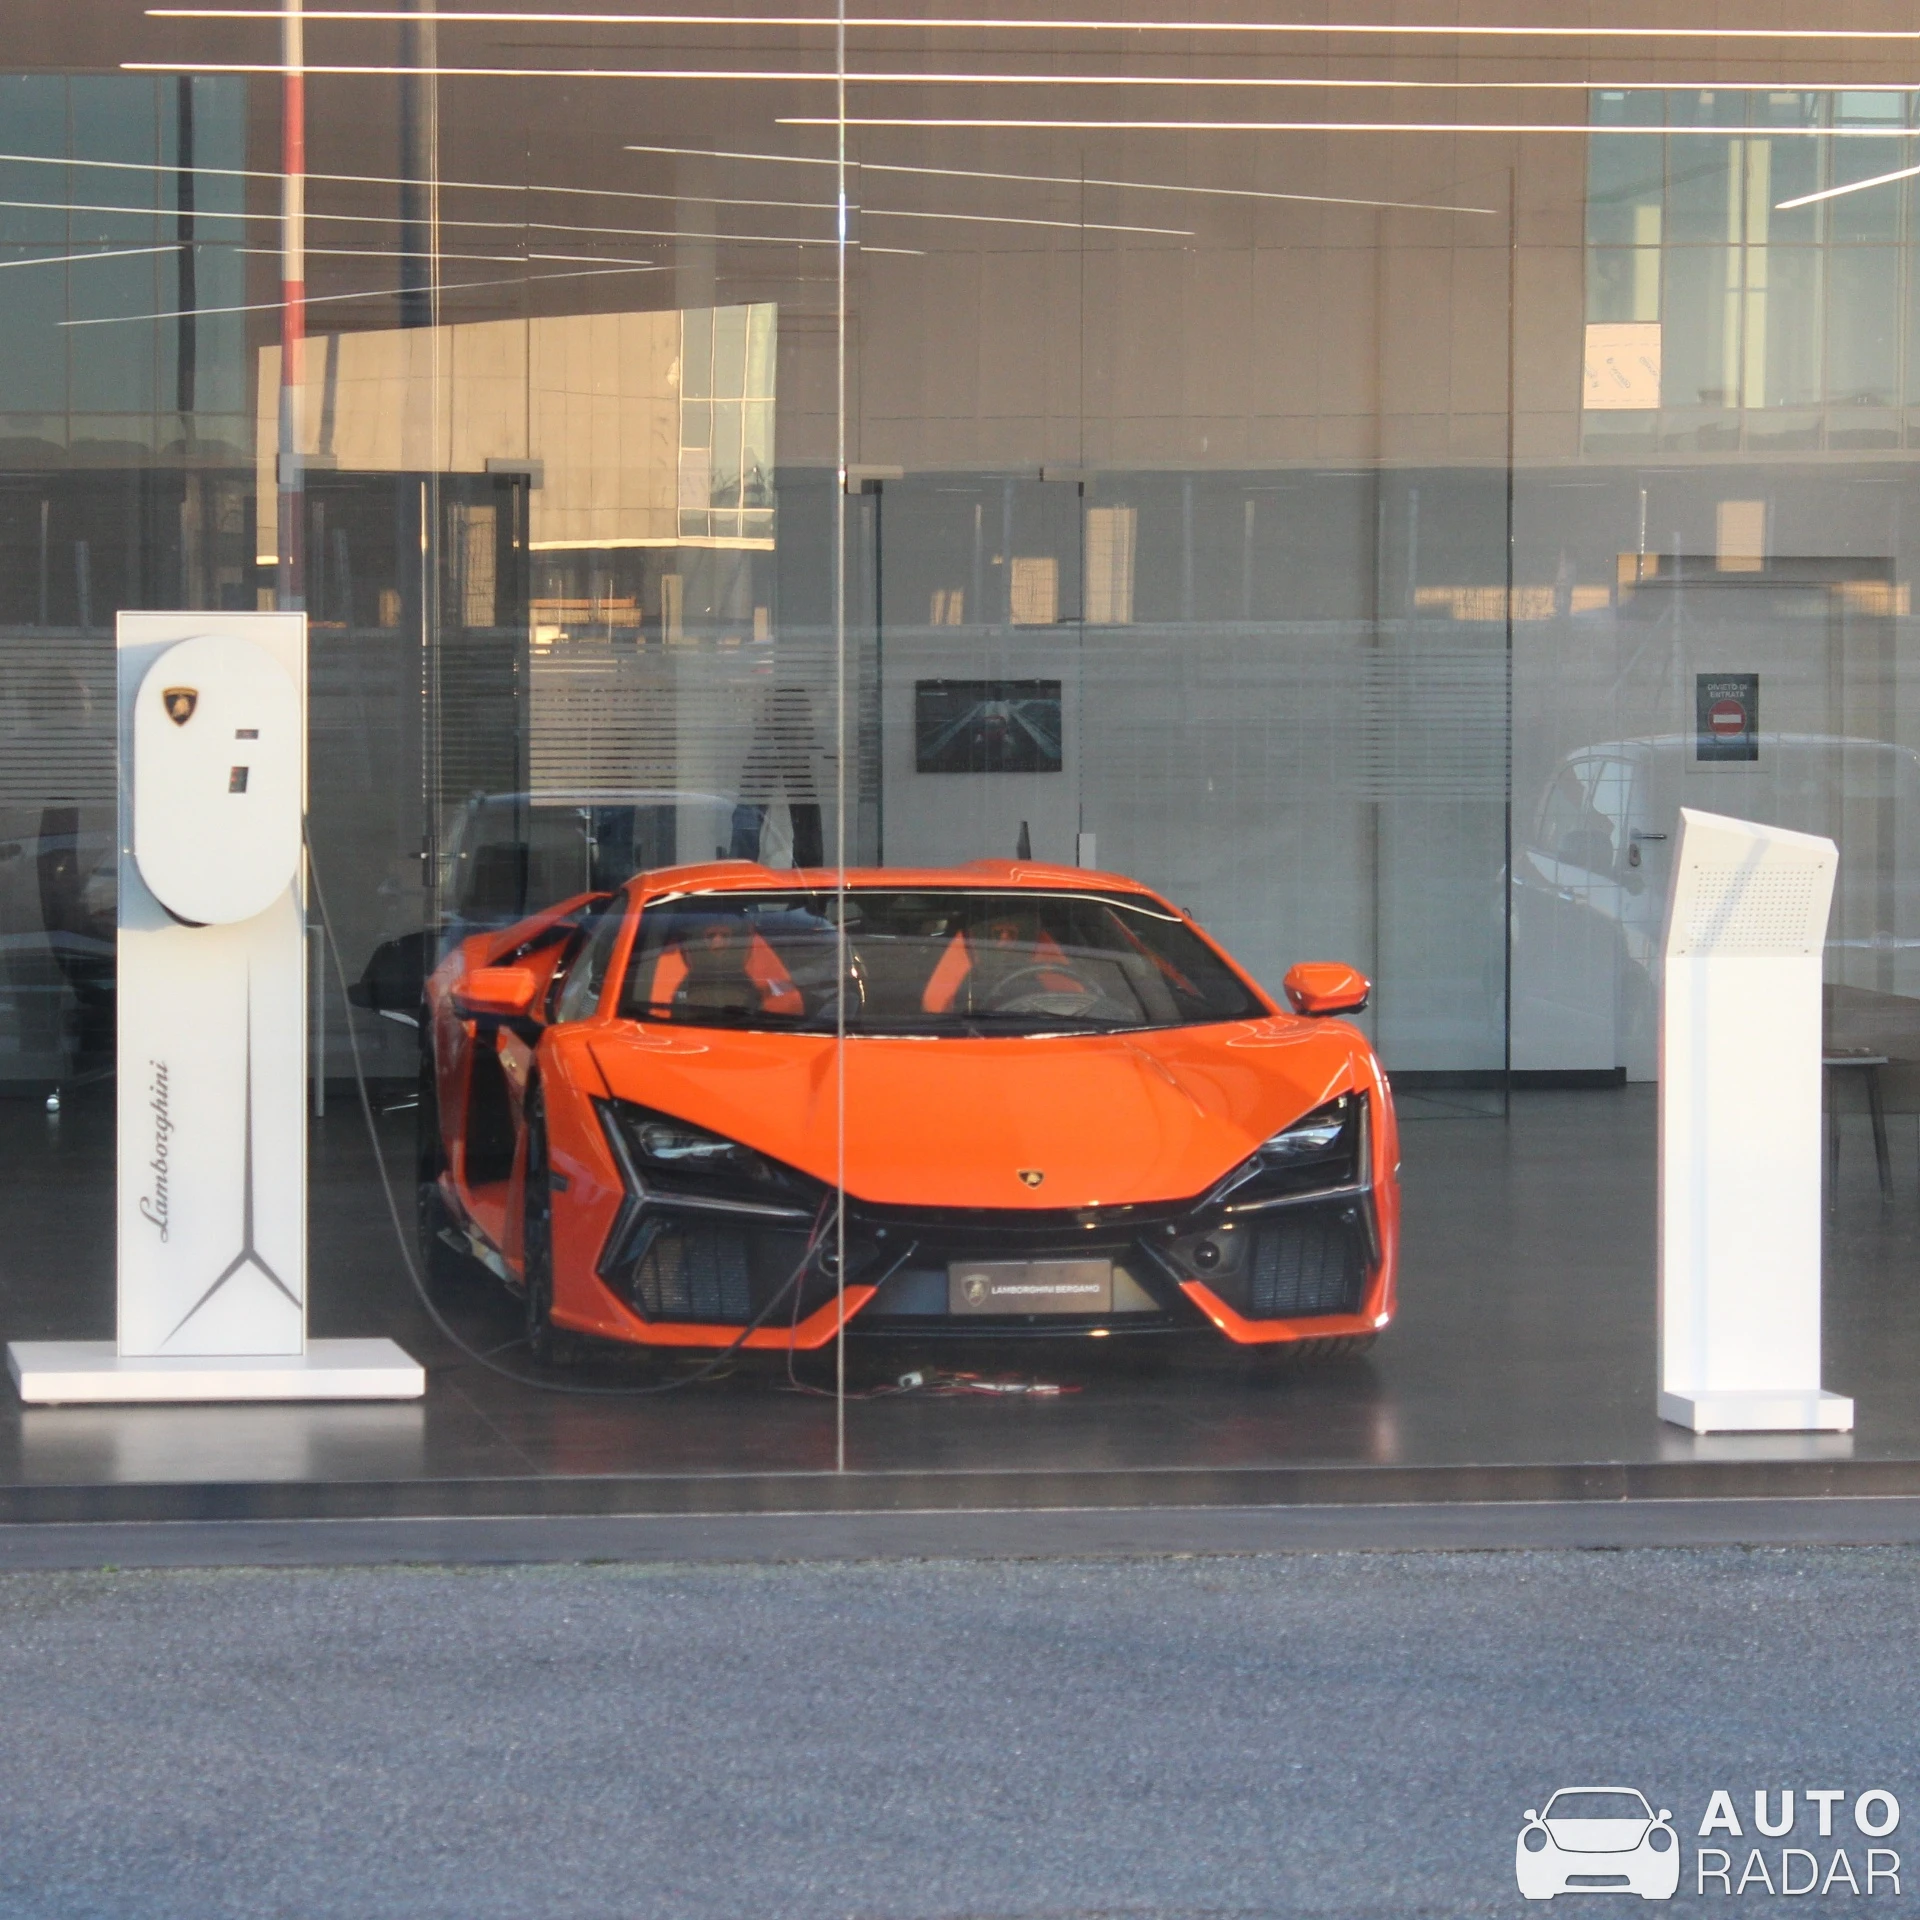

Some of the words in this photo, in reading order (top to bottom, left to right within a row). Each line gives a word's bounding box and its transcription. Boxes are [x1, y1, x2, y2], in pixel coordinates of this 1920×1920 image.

[1707, 683, 1738, 691] DIVIETO
[1739, 683, 1748, 691] DI
[139, 1059, 175, 1243] Lamborghini
[991, 1285, 1054, 1295] LAMBORGHINI
[1055, 1284, 1100, 1293] BERGAMO
